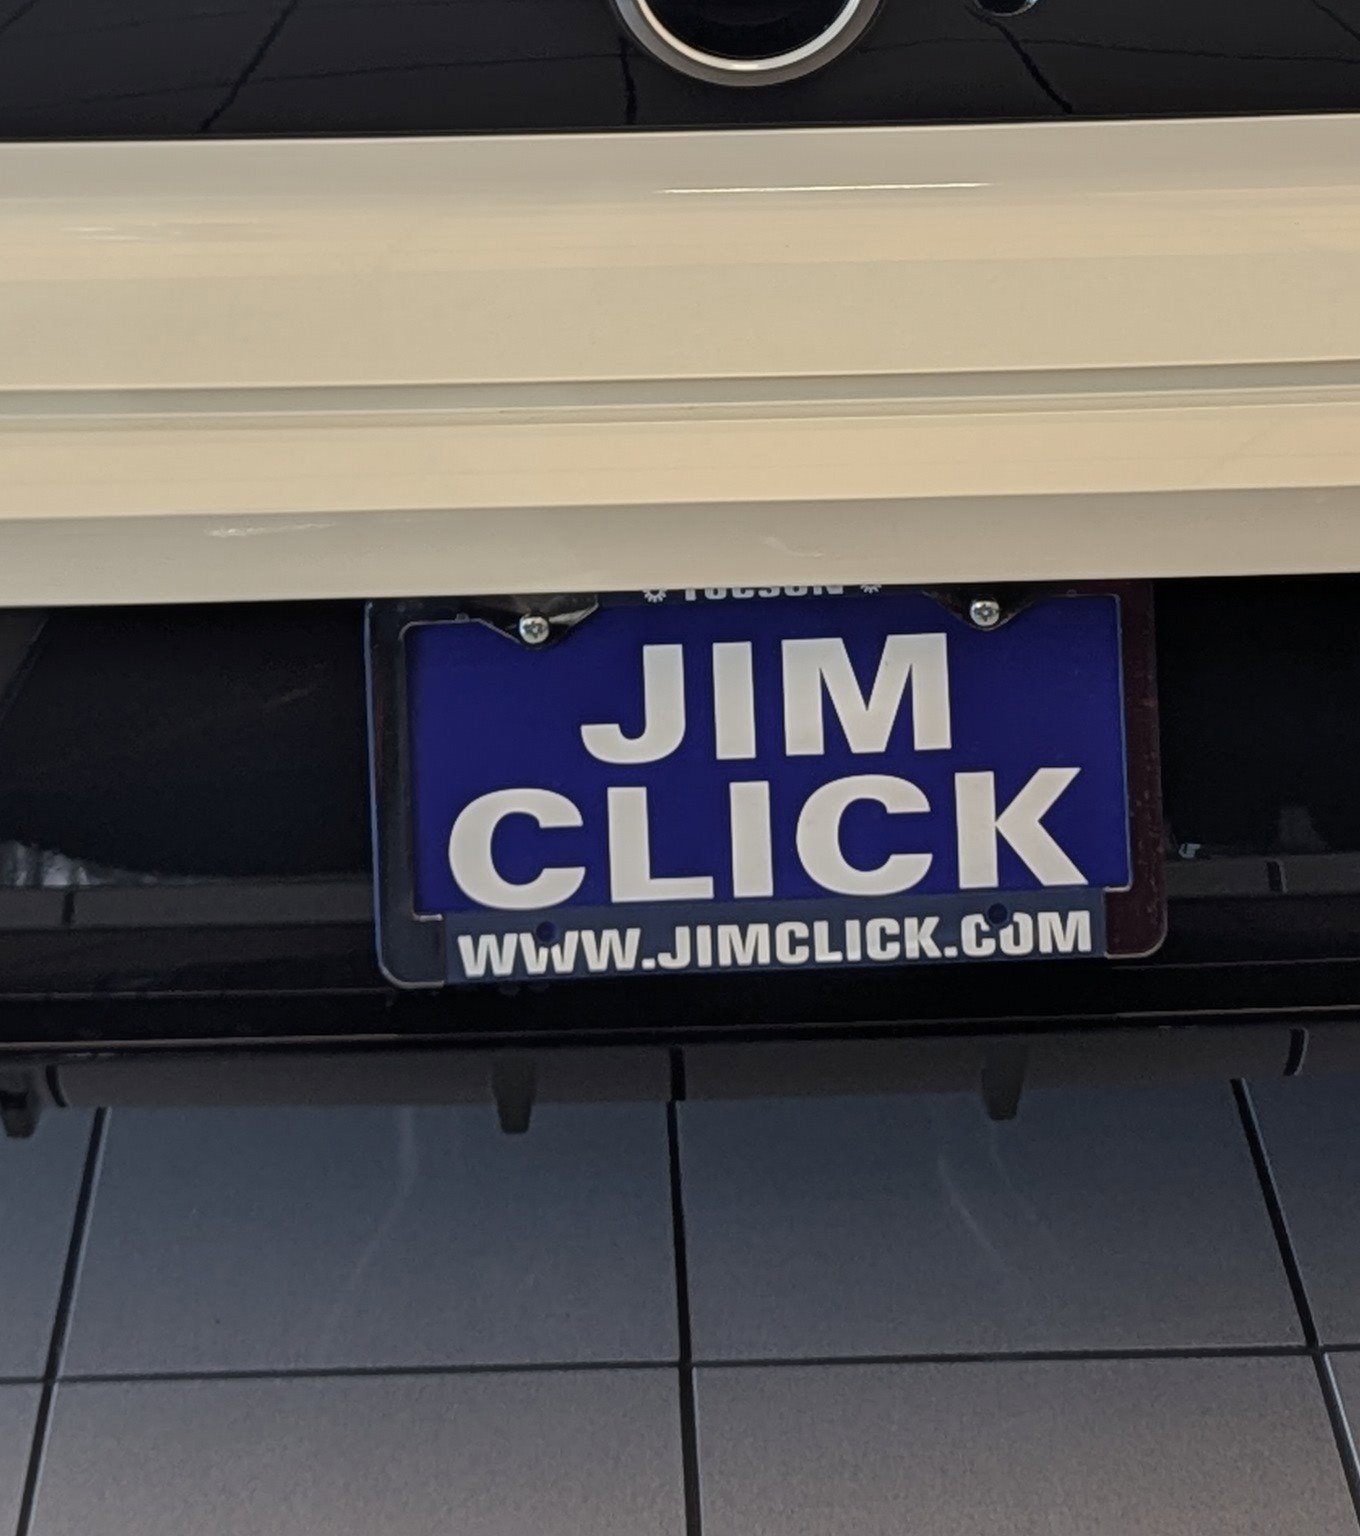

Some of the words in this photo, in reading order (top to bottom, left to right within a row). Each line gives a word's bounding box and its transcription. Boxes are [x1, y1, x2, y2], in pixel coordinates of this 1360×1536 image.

[580, 631, 953, 765] JIM
[447, 767, 1090, 910] CLICK
[457, 910, 1092, 978] WWW.JIMCLICK.COM
